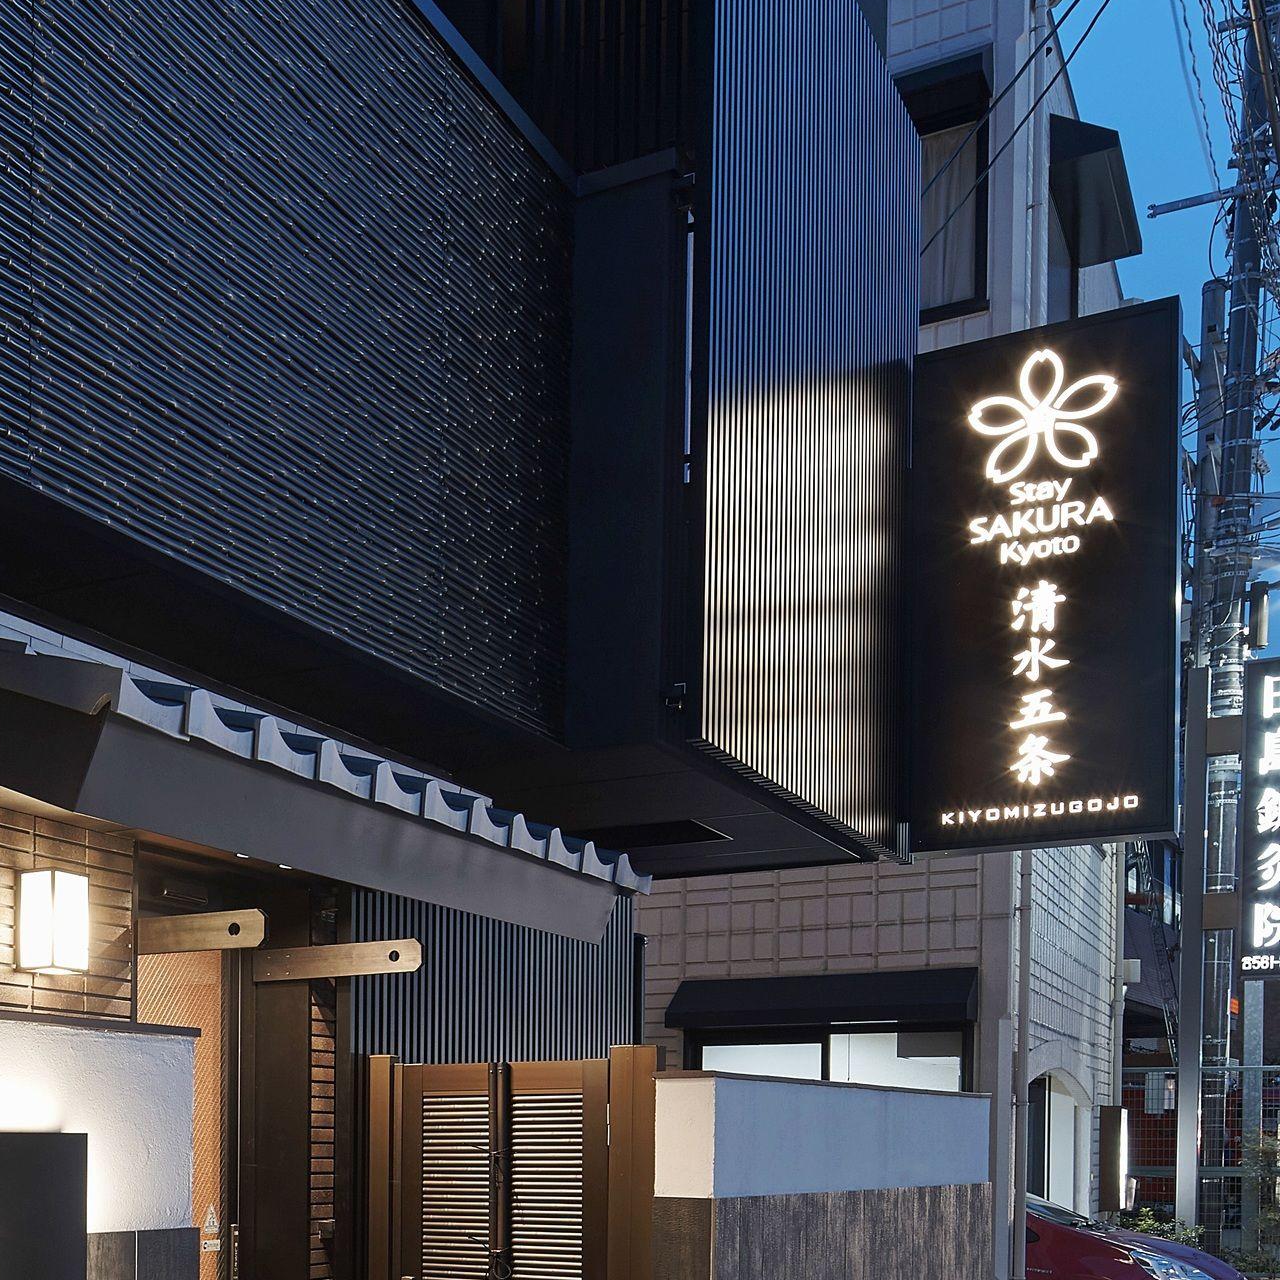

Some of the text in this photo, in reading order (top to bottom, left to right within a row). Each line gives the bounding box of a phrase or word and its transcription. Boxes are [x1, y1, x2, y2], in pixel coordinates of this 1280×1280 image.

[1008, 477, 1073, 506] Stay
[968, 496, 1115, 545] SAKURA
[1000, 534, 1082, 566] Kyoto
[1010, 579, 1071, 787] 清水五条
[941, 795, 1140, 825] KIYOMIZUGOJO
